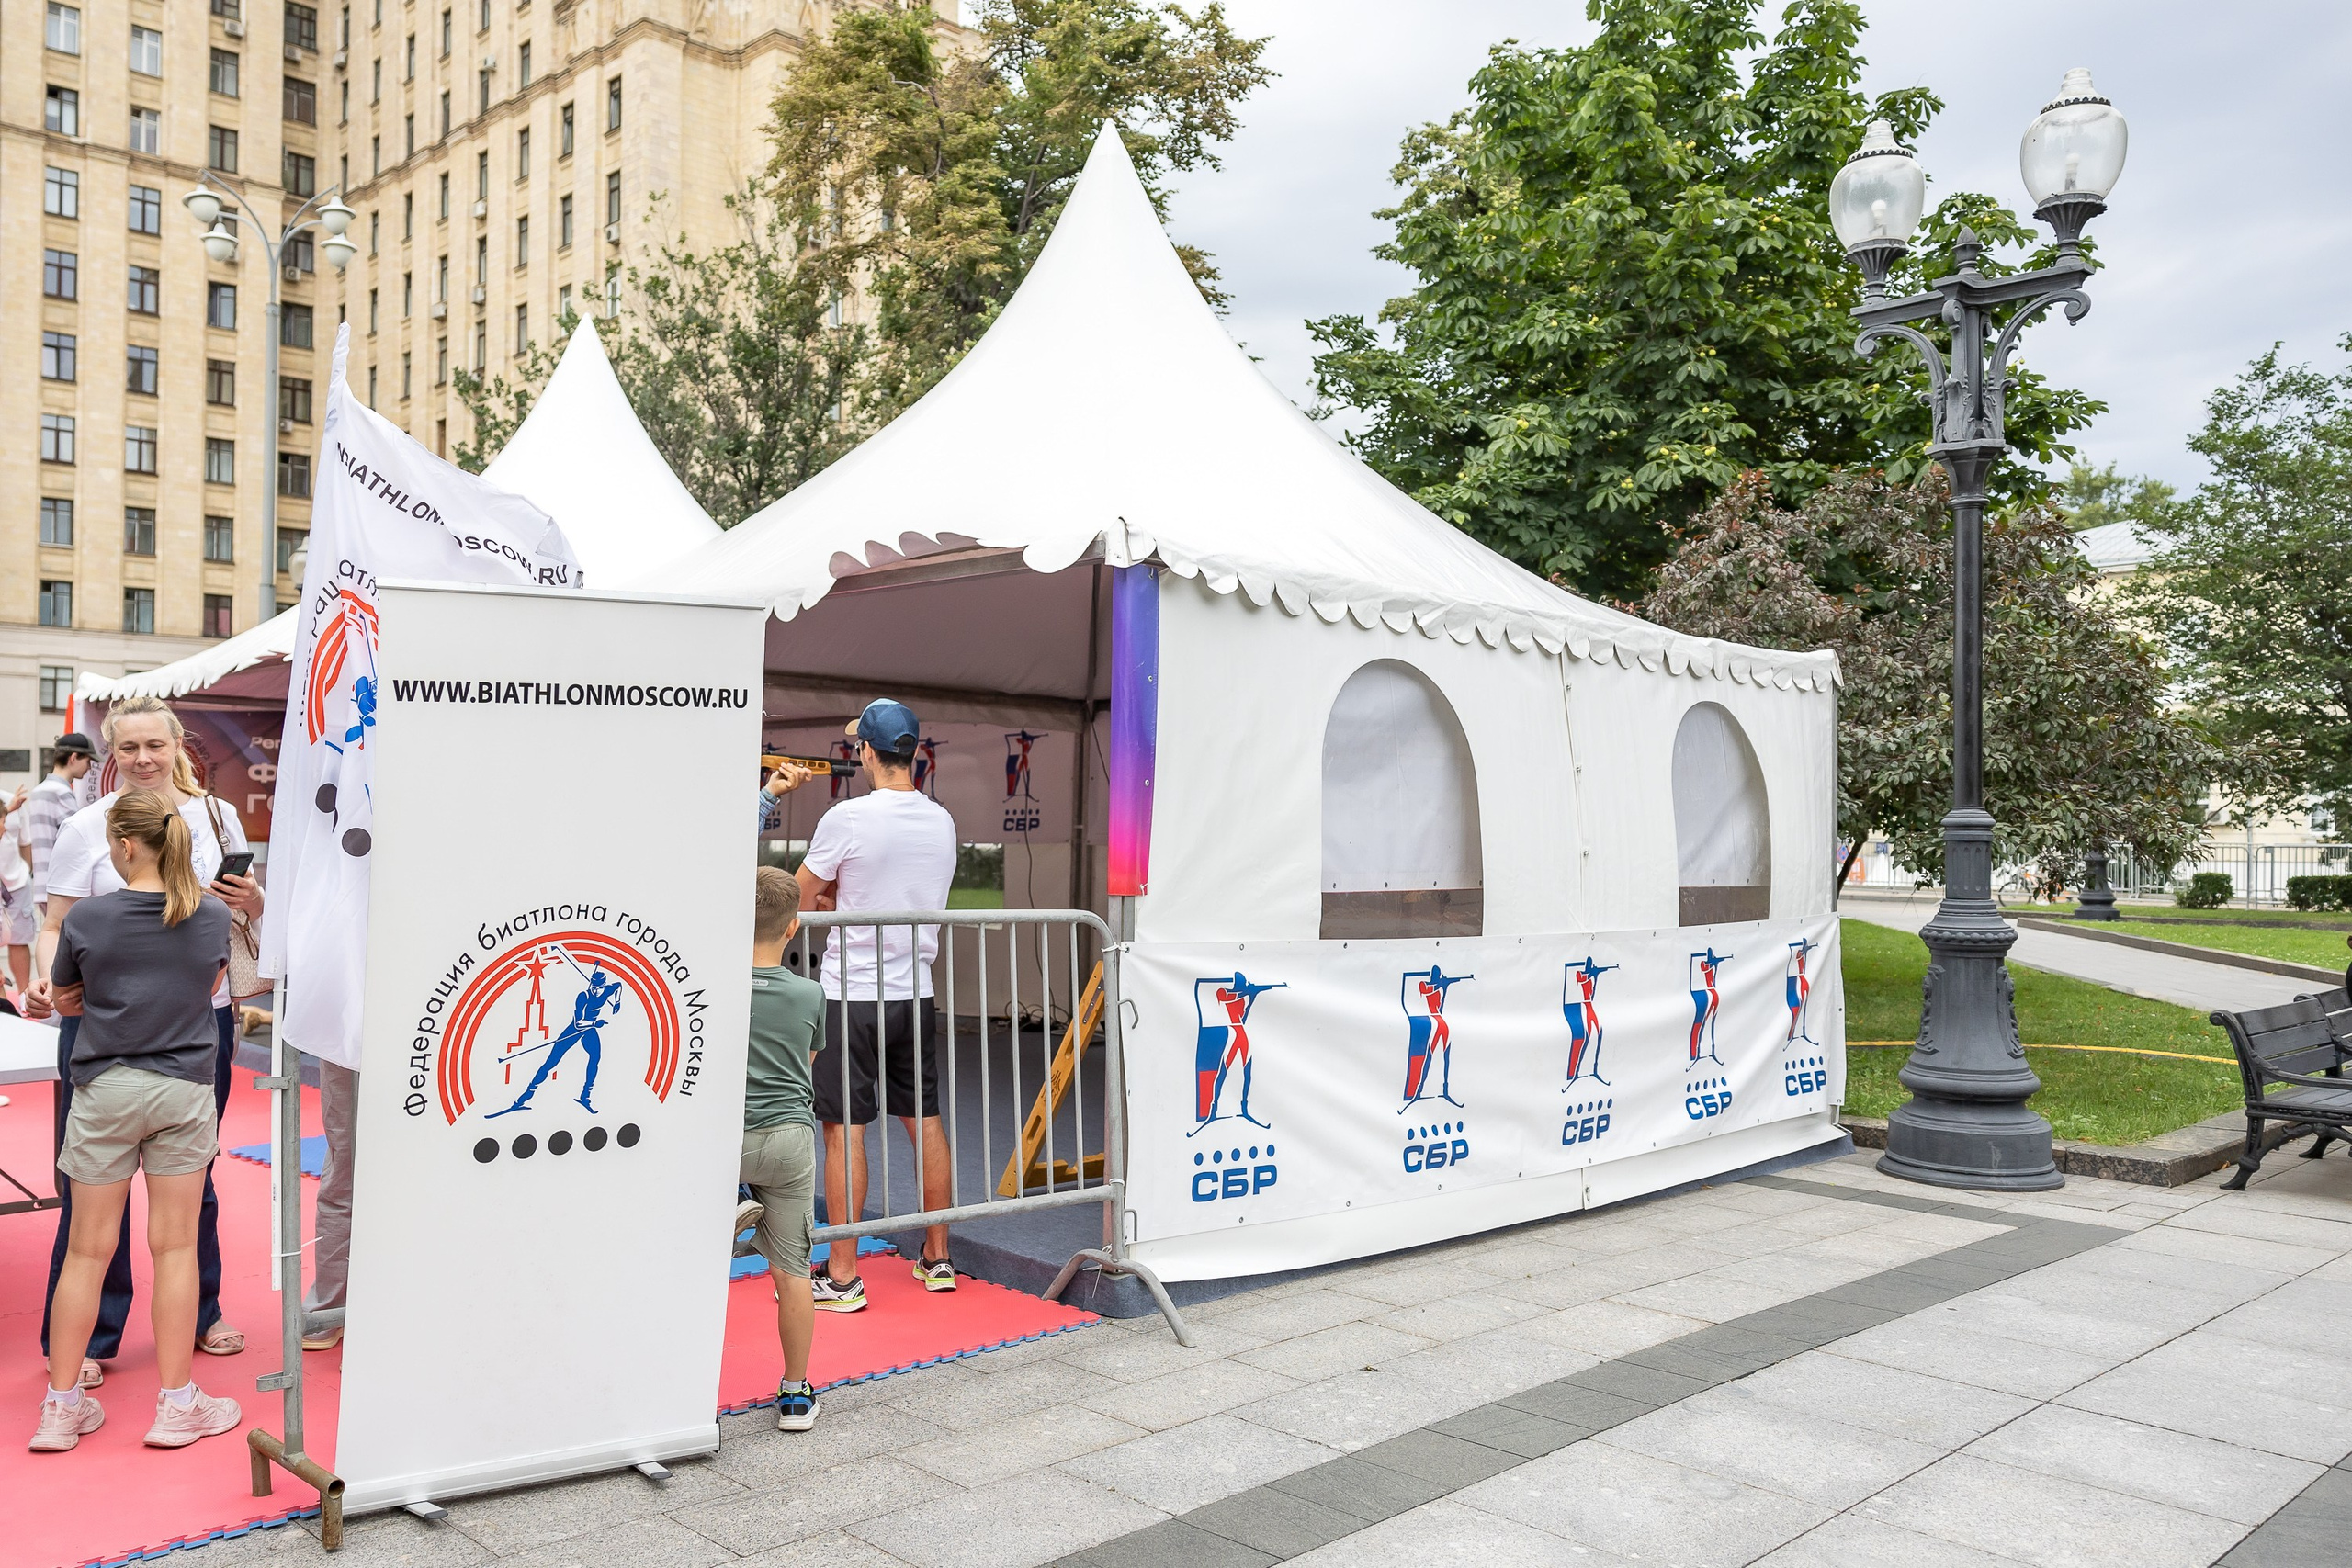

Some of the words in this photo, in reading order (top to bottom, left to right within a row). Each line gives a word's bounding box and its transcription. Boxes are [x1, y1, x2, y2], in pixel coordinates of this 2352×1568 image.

[392, 679, 748, 709] WWW.BIATHLONMOSCOW.RU
[764, 818, 781, 830] БР
[1003, 818, 1040, 831] СБР
[403, 953, 476, 1117] Федерация
[477, 903, 607, 951] биатлона
[616, 912, 691, 984] города
[680, 988, 710, 1097] Москвы
[1786, 1069, 1826, 1097] СБР
[1686, 1090, 1733, 1121] СБР
[1561, 1113, 1611, 1146] СБР
[1402, 1138, 1469, 1174] СБР
[1191, 1163, 1278, 1202] СБР
